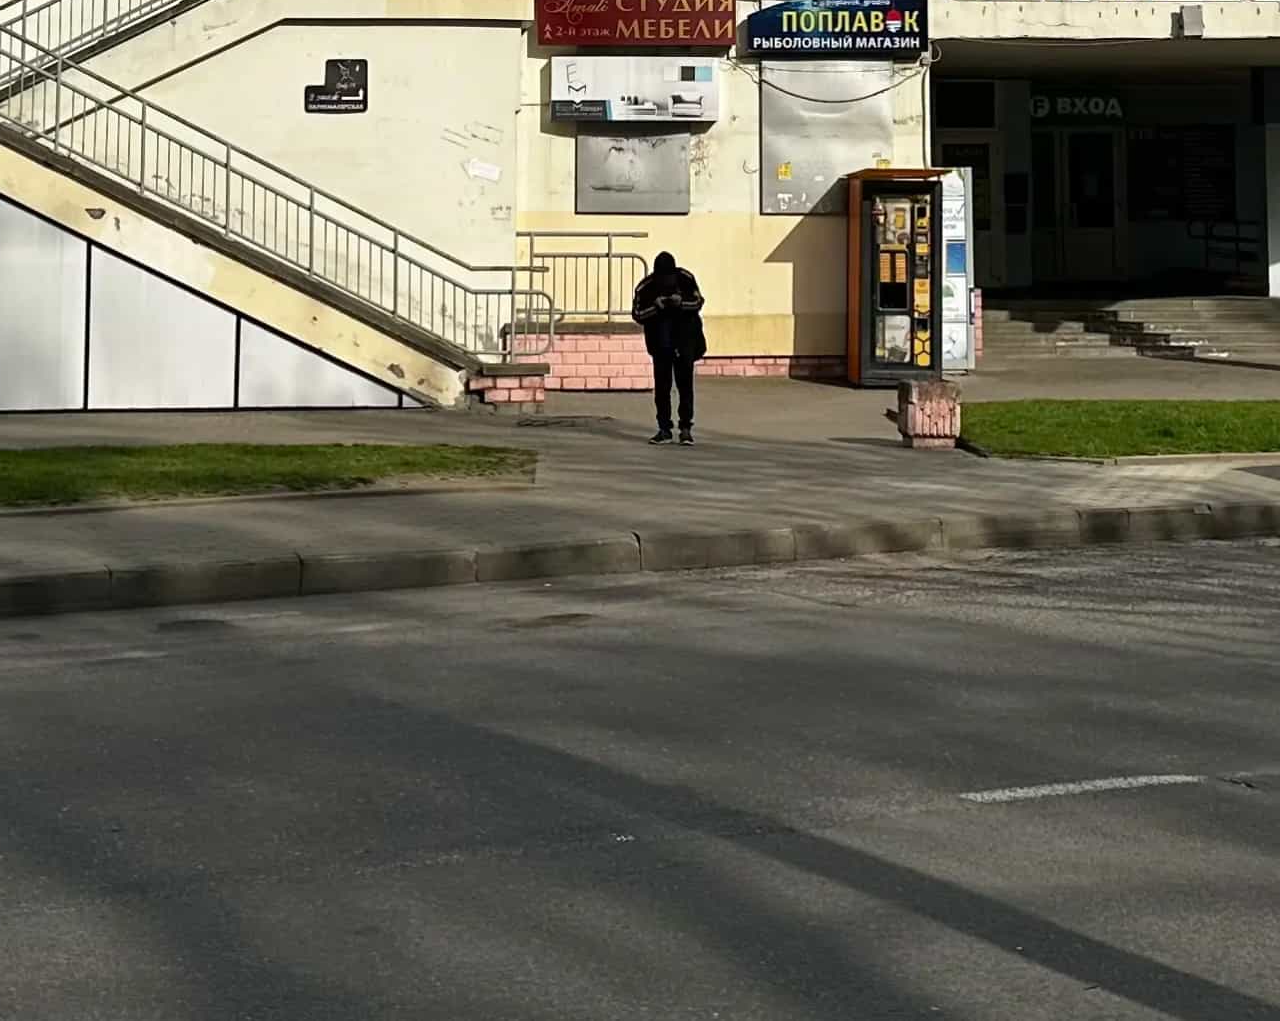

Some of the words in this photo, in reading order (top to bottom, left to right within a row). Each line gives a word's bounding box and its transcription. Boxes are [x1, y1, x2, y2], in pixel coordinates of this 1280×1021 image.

[581, 27, 611, 37] этаж
[615, 19, 733, 39] МЕБЕЛИ
[753, 35, 852, 49] РЫБОЛОВНЫЙ
[855, 37, 920, 49] МАГАЗИН
[1056, 95, 1124, 119] ВХОД
